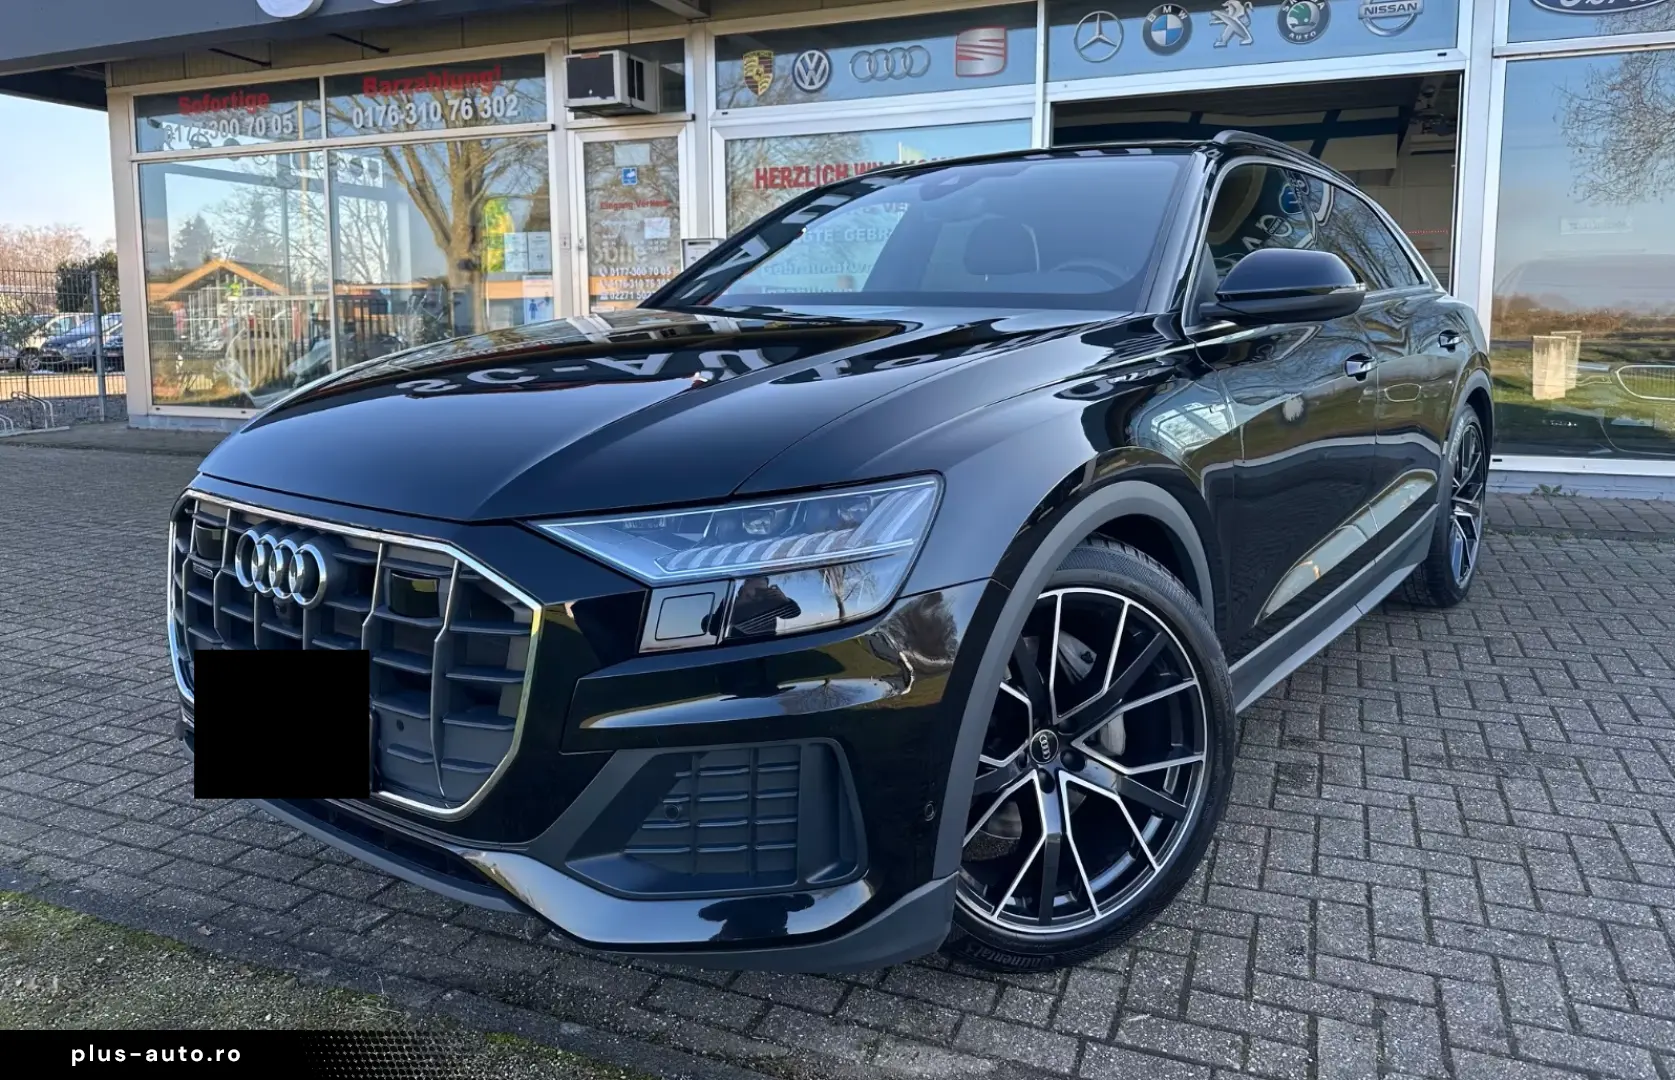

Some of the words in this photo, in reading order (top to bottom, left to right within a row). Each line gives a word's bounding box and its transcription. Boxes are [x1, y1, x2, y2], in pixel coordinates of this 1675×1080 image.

[1364, 2, 1418, 16] NISSAN
[1288, 30, 1317, 41] AUTO
[362, 64, 503, 97] Barzahlung!
[178, 91, 271, 116] Sofortige
[352, 101, 442, 129] 0176-310
[448, 97, 473, 121] 76
[480, 94, 519, 119] 302
[247, 115, 266, 137] 70
[271, 114, 294, 135] 05
[754, 162, 849, 190] HERZLICH
[844, 227, 893, 243] GEBR
